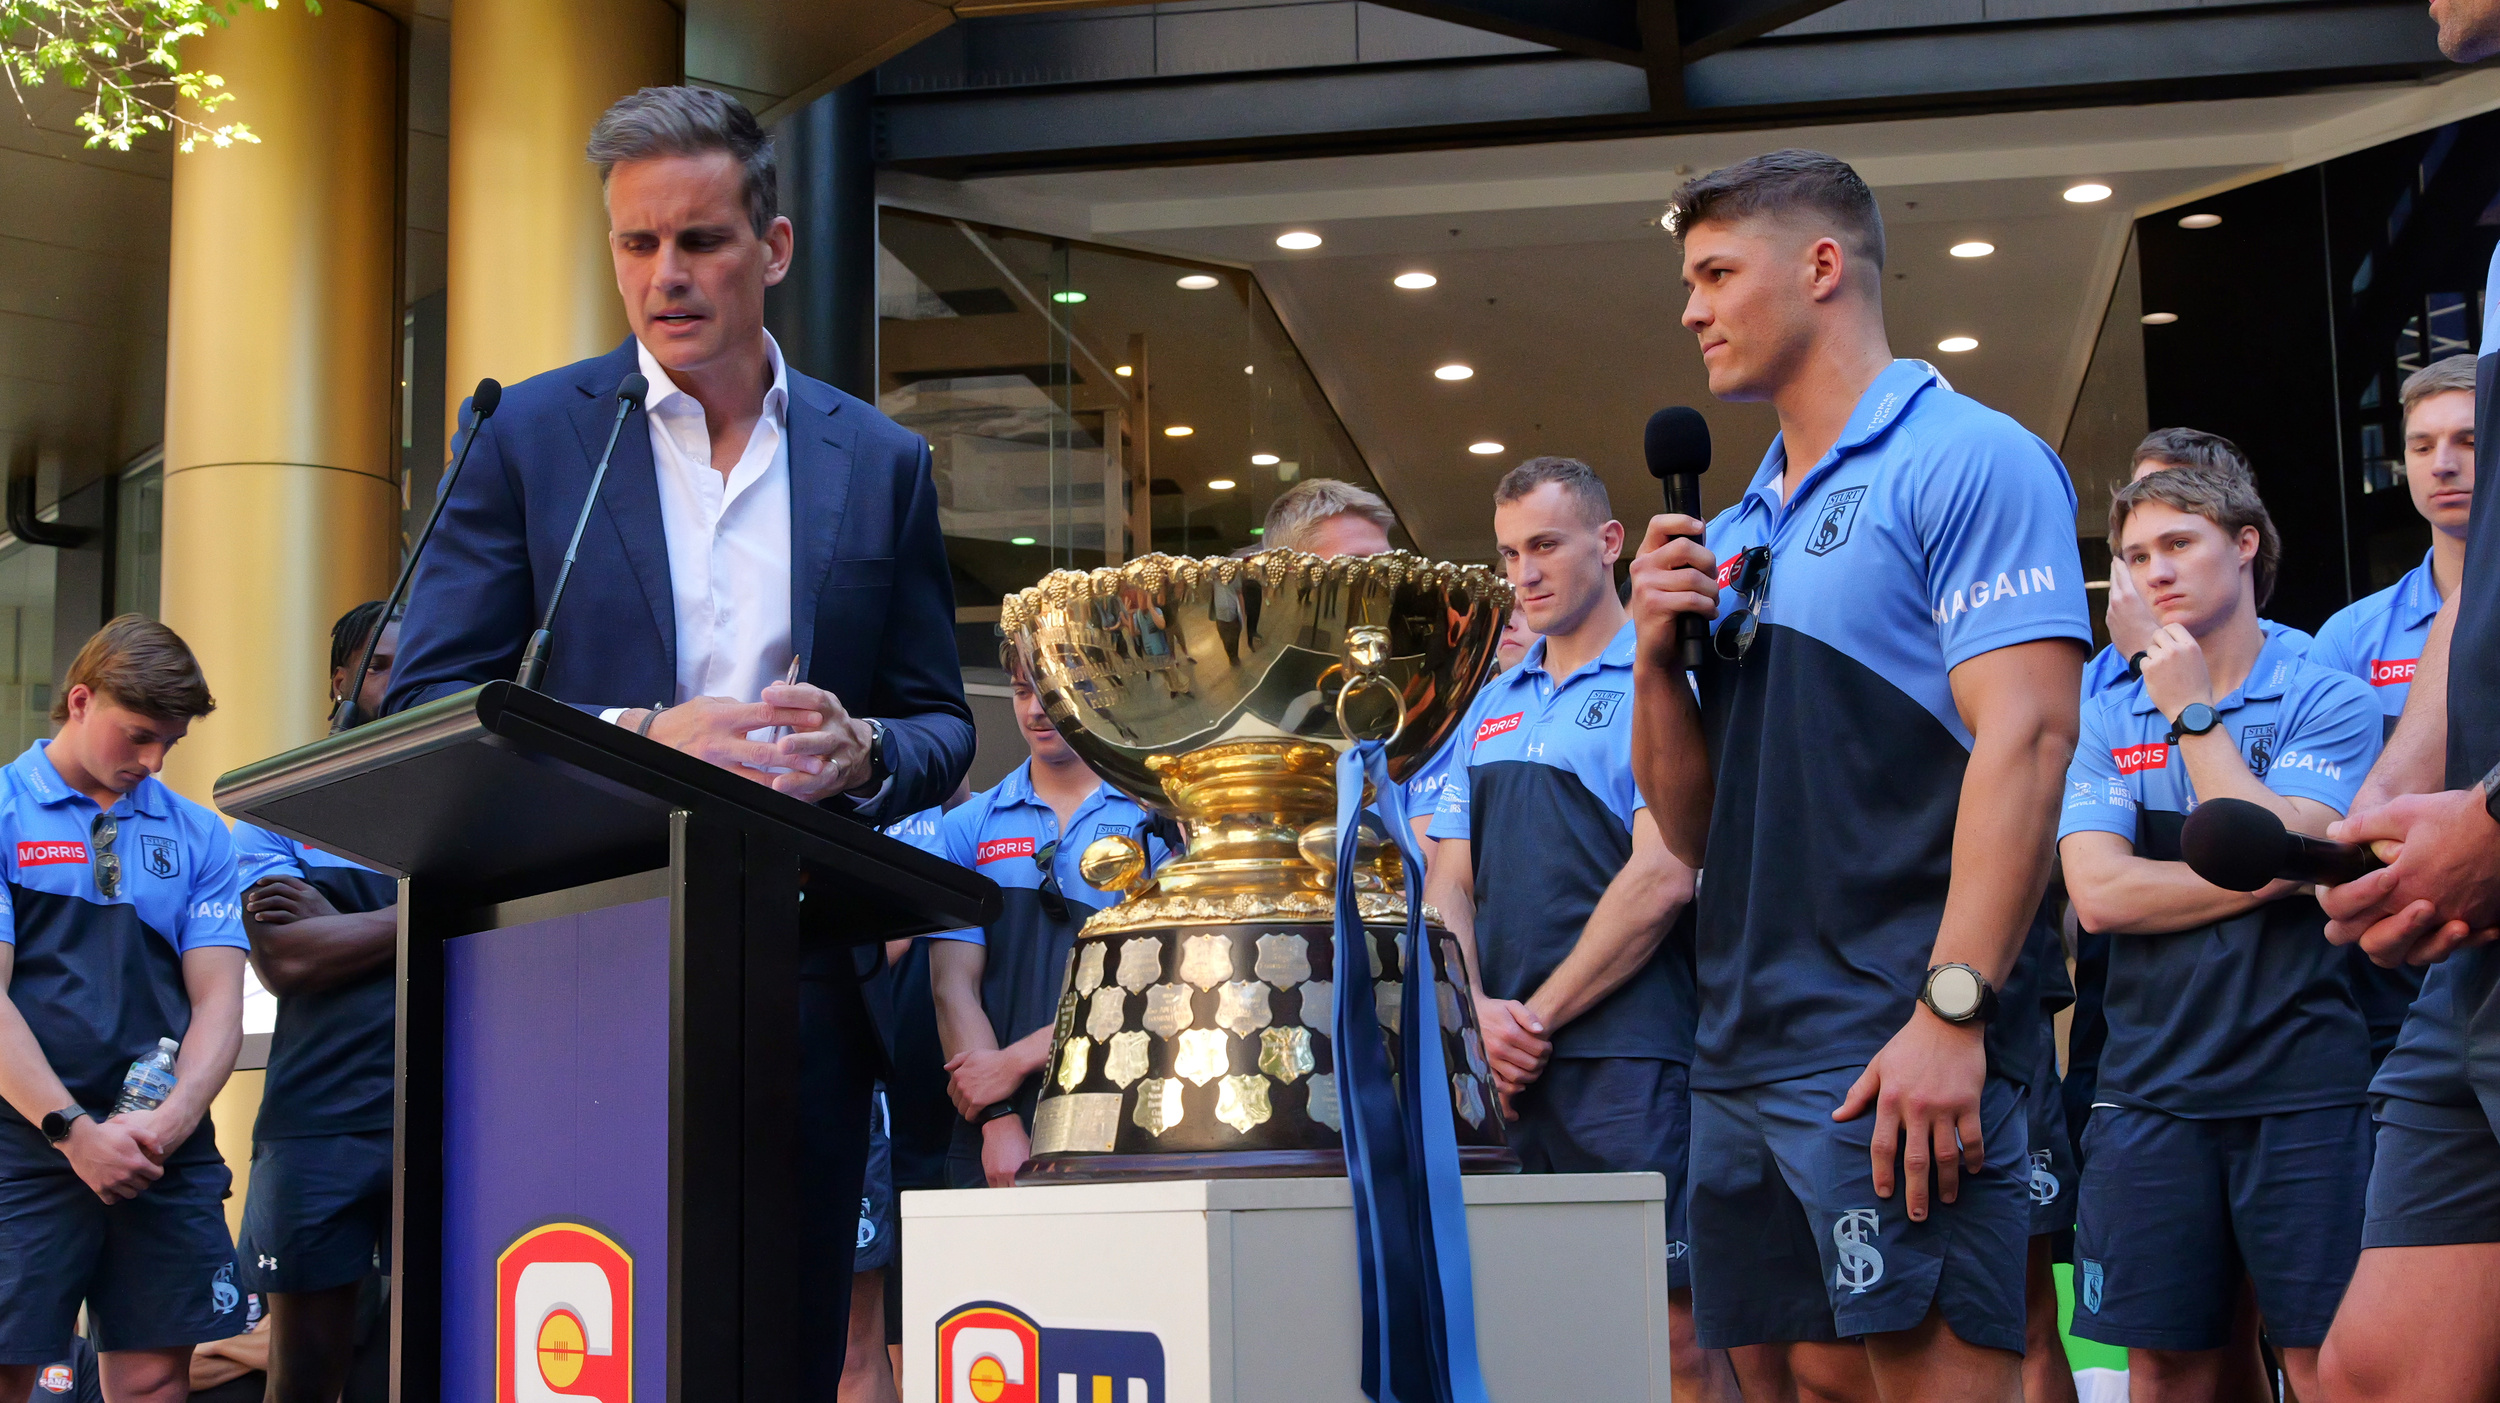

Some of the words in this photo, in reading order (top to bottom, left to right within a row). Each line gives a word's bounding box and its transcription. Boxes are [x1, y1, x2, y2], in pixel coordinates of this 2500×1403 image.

[1867, 392, 1894, 431] THOMAS
[1828, 490, 1861, 505] STURT
[1717, 558, 1744, 584] RIS
[2248, 726, 2274, 736] STUR
[1099, 825, 1128, 835] STURT
[146, 836, 173, 848] STURT
[19, 846, 87, 862] MORRIS
